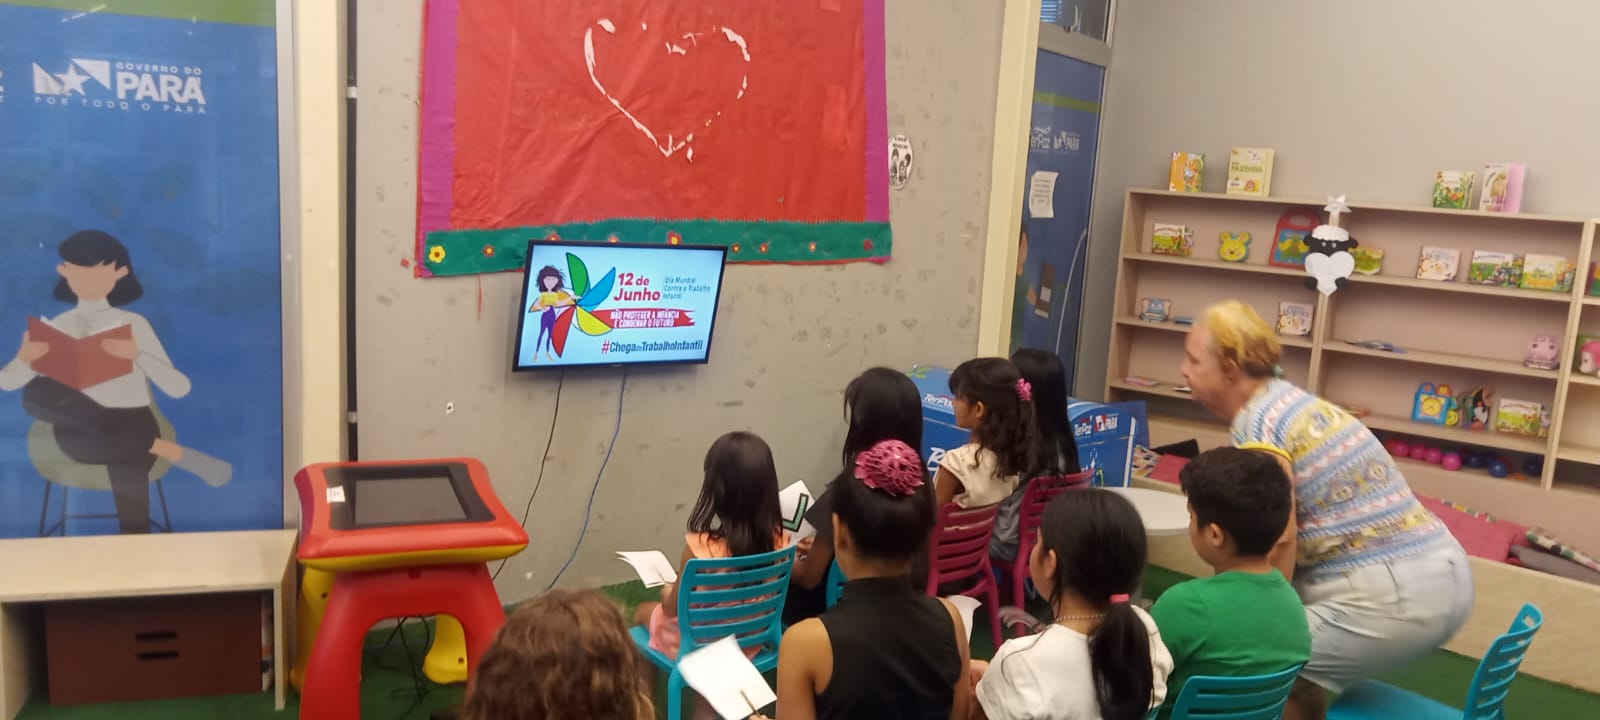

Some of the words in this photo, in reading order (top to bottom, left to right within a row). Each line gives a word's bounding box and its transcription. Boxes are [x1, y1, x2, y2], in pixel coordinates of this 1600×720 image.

[116, 62, 178, 74] GOVERNO
[184, 67, 202, 76] DO
[116, 71, 206, 105] PARÁ
[34, 96, 69, 106] POR
[81, 99, 129, 110] TODO
[142, 103, 151, 111] O
[618, 272, 634, 286] 12
[636, 276, 650, 286] de
[614, 288, 660, 301] Junho
[611, 309, 622, 319] NÃO
[623, 311, 650, 319] PROTEGER
[657, 310, 680, 319] INFÂNCIA
[619, 319, 647, 328] CONDENAR
[647, 319, 652, 327] O
